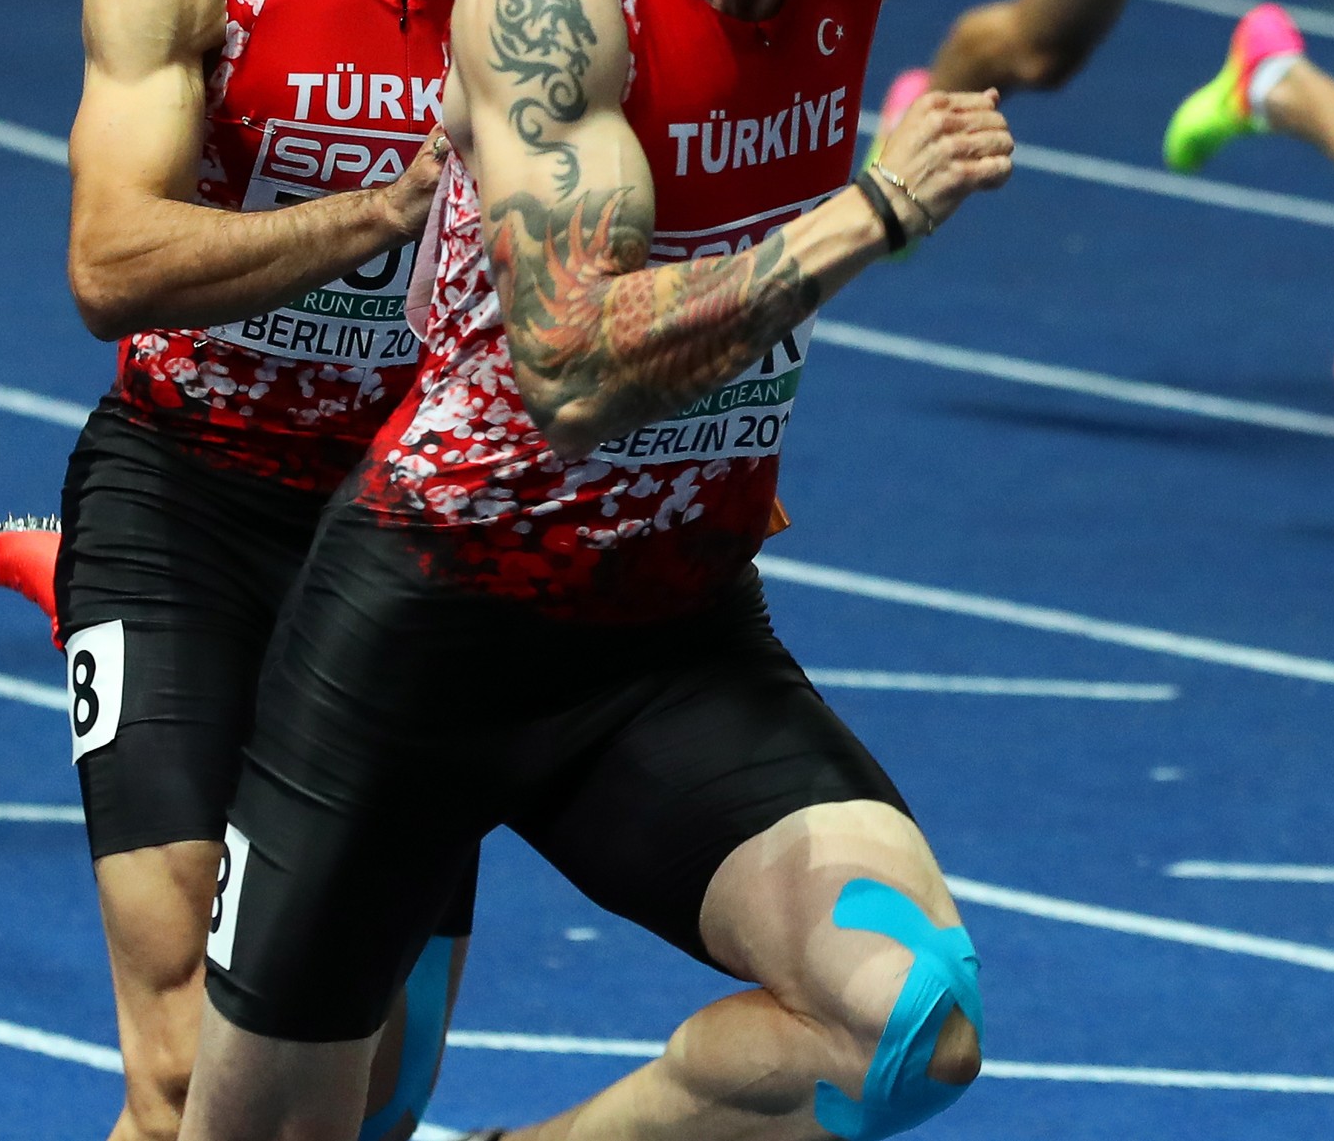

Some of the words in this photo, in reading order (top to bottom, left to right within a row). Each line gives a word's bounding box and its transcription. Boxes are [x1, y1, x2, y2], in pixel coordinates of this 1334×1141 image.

[287, 62, 443, 122] TÜRK
[668, 85, 846, 177] TÜRKİYE
[270, 135, 405, 189] SPA
[303, 291, 354, 315] RUN
[359, 298, 406, 318] CLEA
[241, 312, 375, 360] BERLIN
[380, 329, 416, 359] 20
[718, 381, 780, 410] CLEAN
[599, 416, 729, 457] BERLIN
[733, 410, 789, 448] 201
[72, 649, 100, 739] 8
